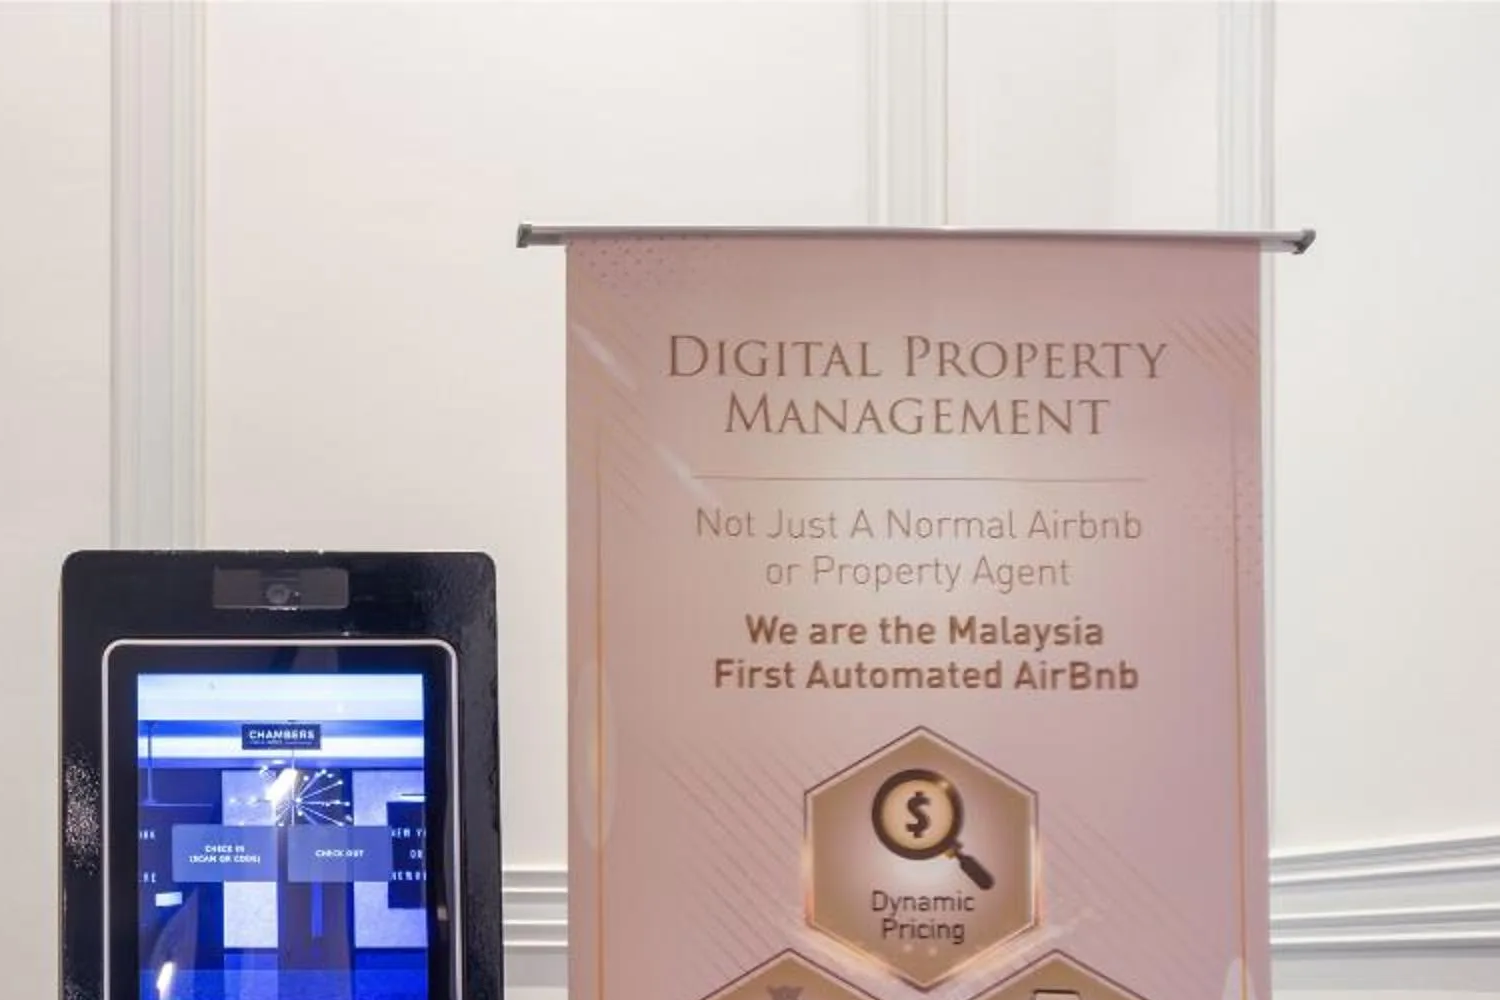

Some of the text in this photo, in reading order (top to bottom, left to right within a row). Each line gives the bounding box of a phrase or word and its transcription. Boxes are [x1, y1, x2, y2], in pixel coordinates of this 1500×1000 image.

[696, 507, 1143, 541] Not Just A Normal Airbnb
[765, 555, 1071, 594] or Property Agent
[745, 614, 1104, 653] We are the Malaysia
[714, 659, 1140, 691] First Automated AirBnb
[871, 890, 975, 917] Dynamic
[882, 918, 966, 944] Pricing
